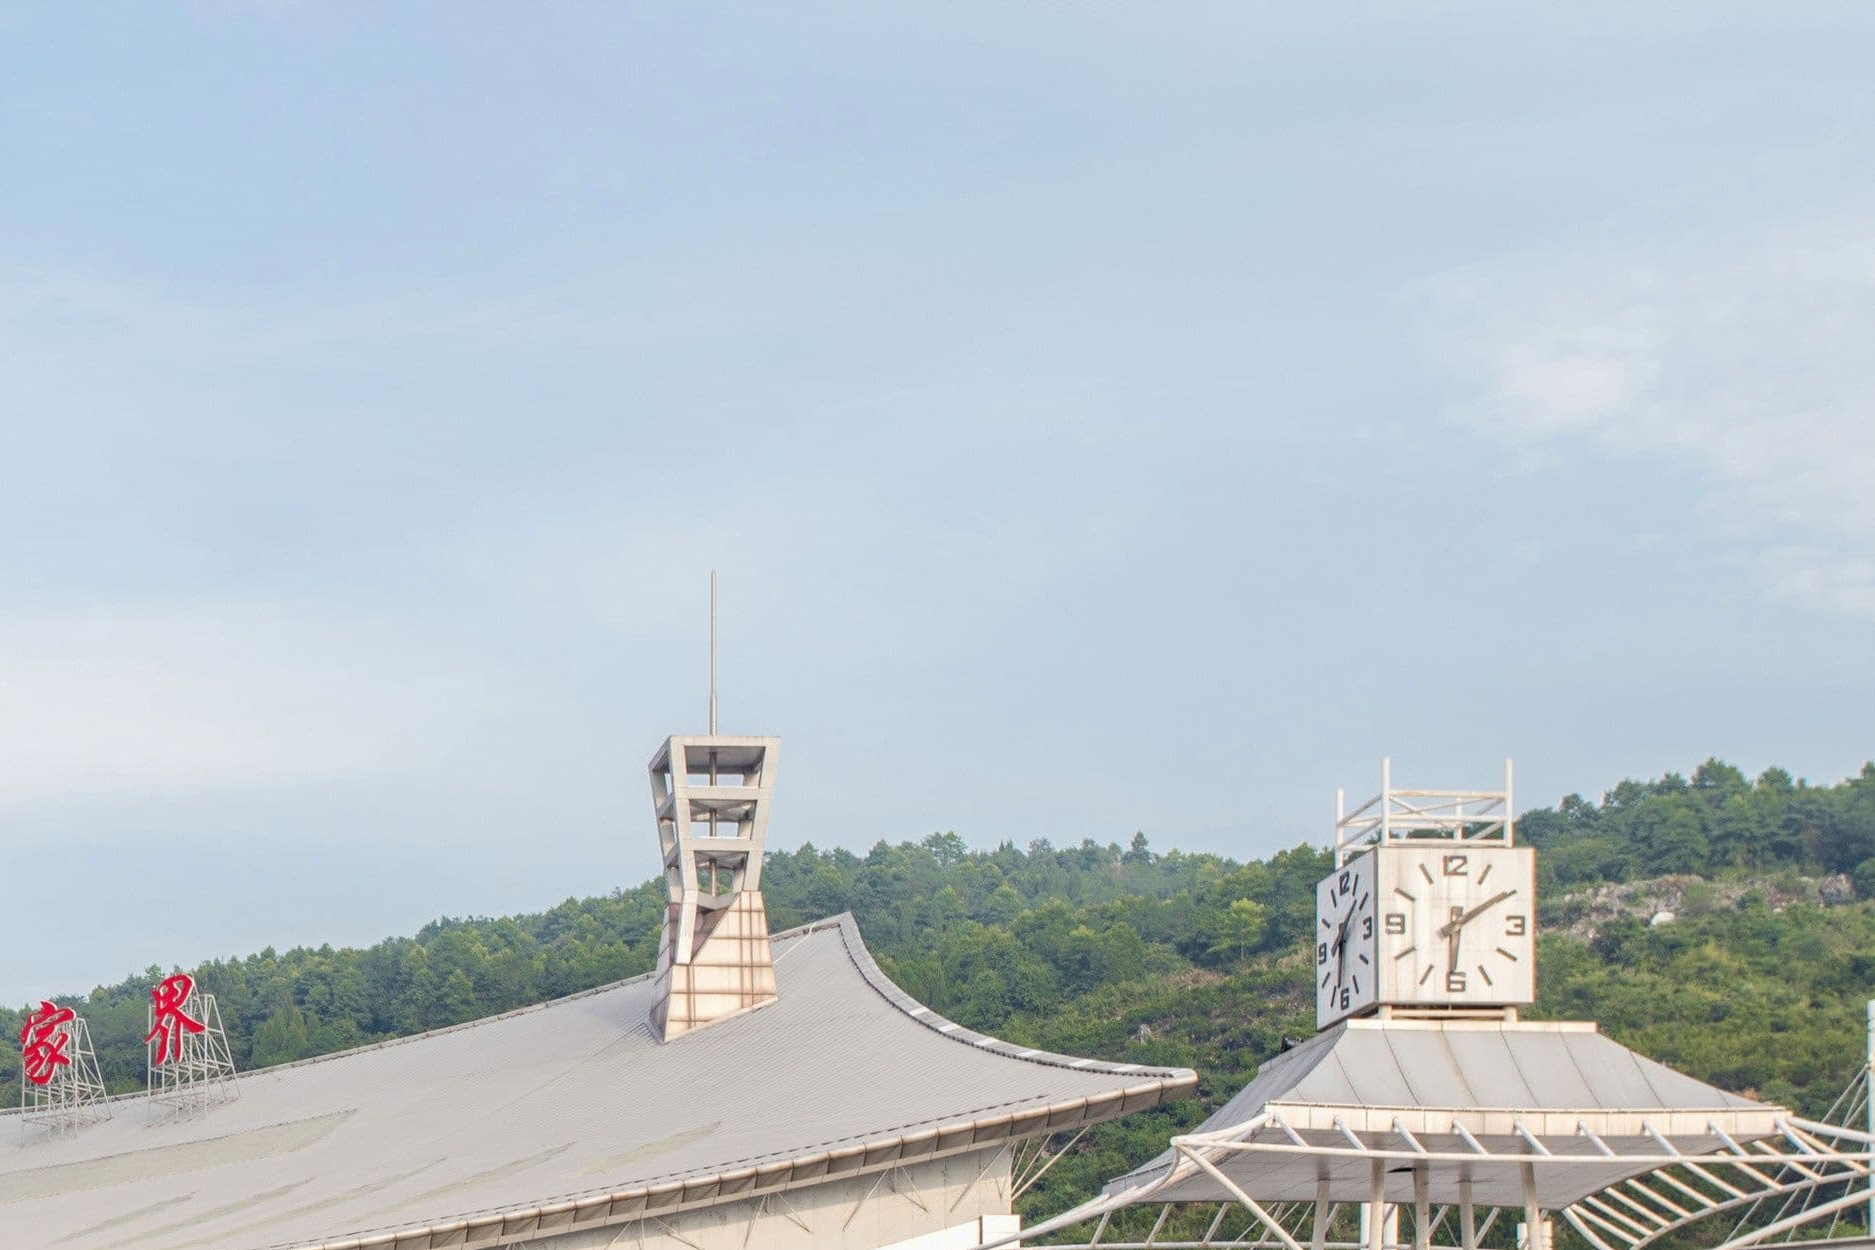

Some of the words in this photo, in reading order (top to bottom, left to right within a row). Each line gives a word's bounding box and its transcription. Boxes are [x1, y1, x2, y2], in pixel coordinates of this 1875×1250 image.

[1443, 856, 1468, 876] 12
[1339, 871, 1350, 897] 12
[1363, 916, 1373, 941] 3
[1385, 913, 1406, 934] 9
[1506, 916, 1526, 936] 3
[1318, 943, 1328, 966] 9
[1446, 971, 1466, 993] 6
[1340, 988, 1350, 1011] 6
